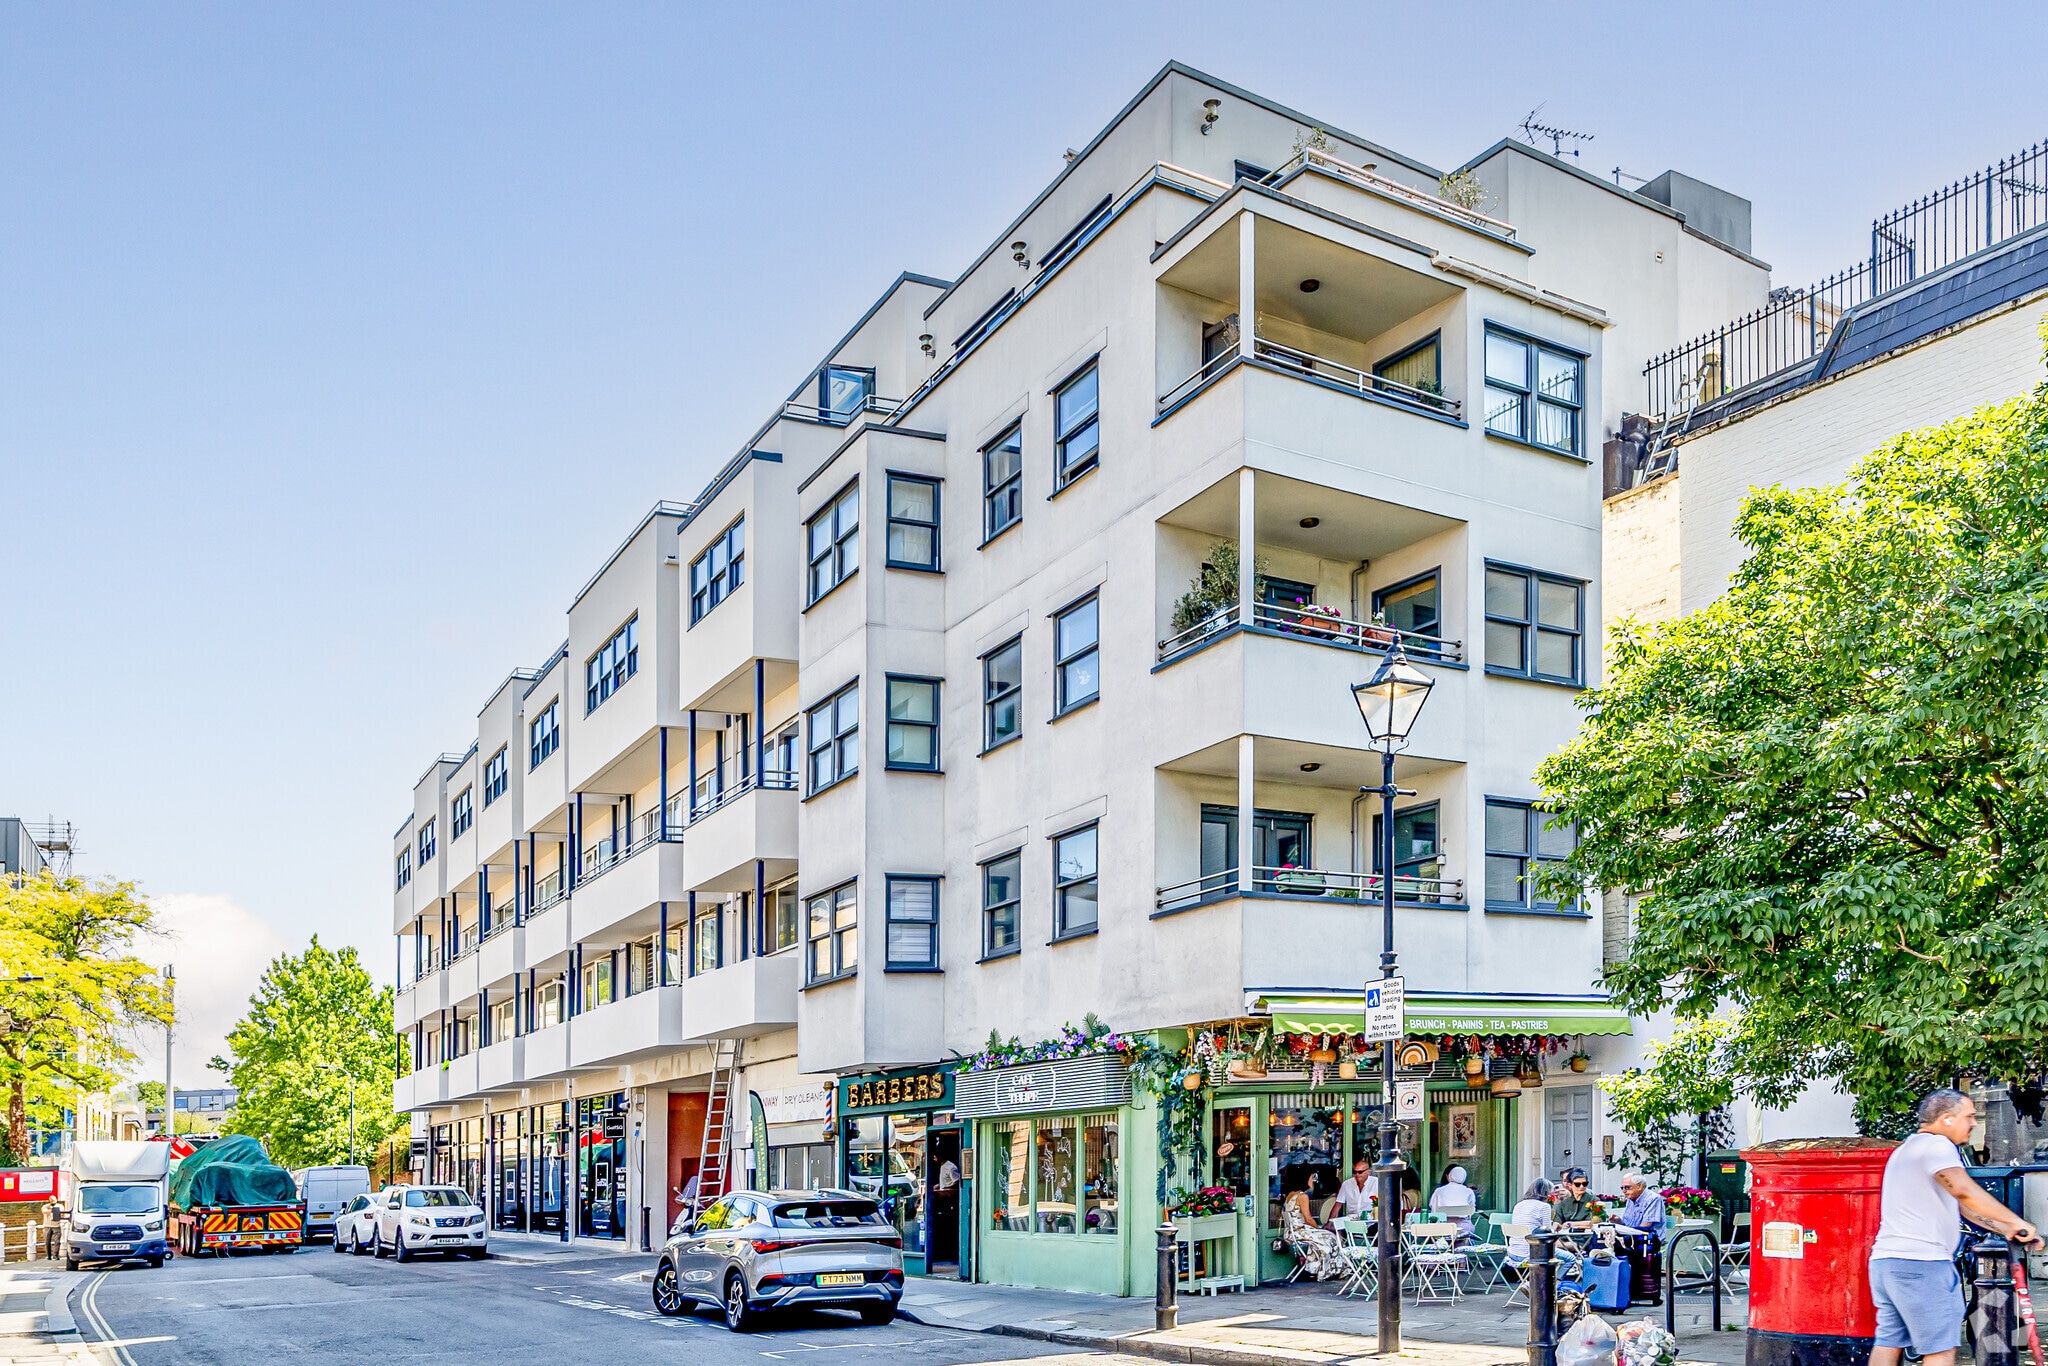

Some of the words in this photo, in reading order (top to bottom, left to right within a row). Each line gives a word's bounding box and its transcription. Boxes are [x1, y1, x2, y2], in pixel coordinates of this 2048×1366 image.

[1409, 1019, 1446, 1029] BRUNCH
[1452, 1020, 1484, 1029] PANINIS
[1490, 1020, 1505, 1030] TEA
[1511, 1020, 1549, 1030] PASTRIES
[848, 1073, 944, 1107] BARBERS
[784, 1094, 798, 1109] DRY
[822, 1275, 844, 1283] FT73
[2017, 1288, 2035, 1324] PURE
